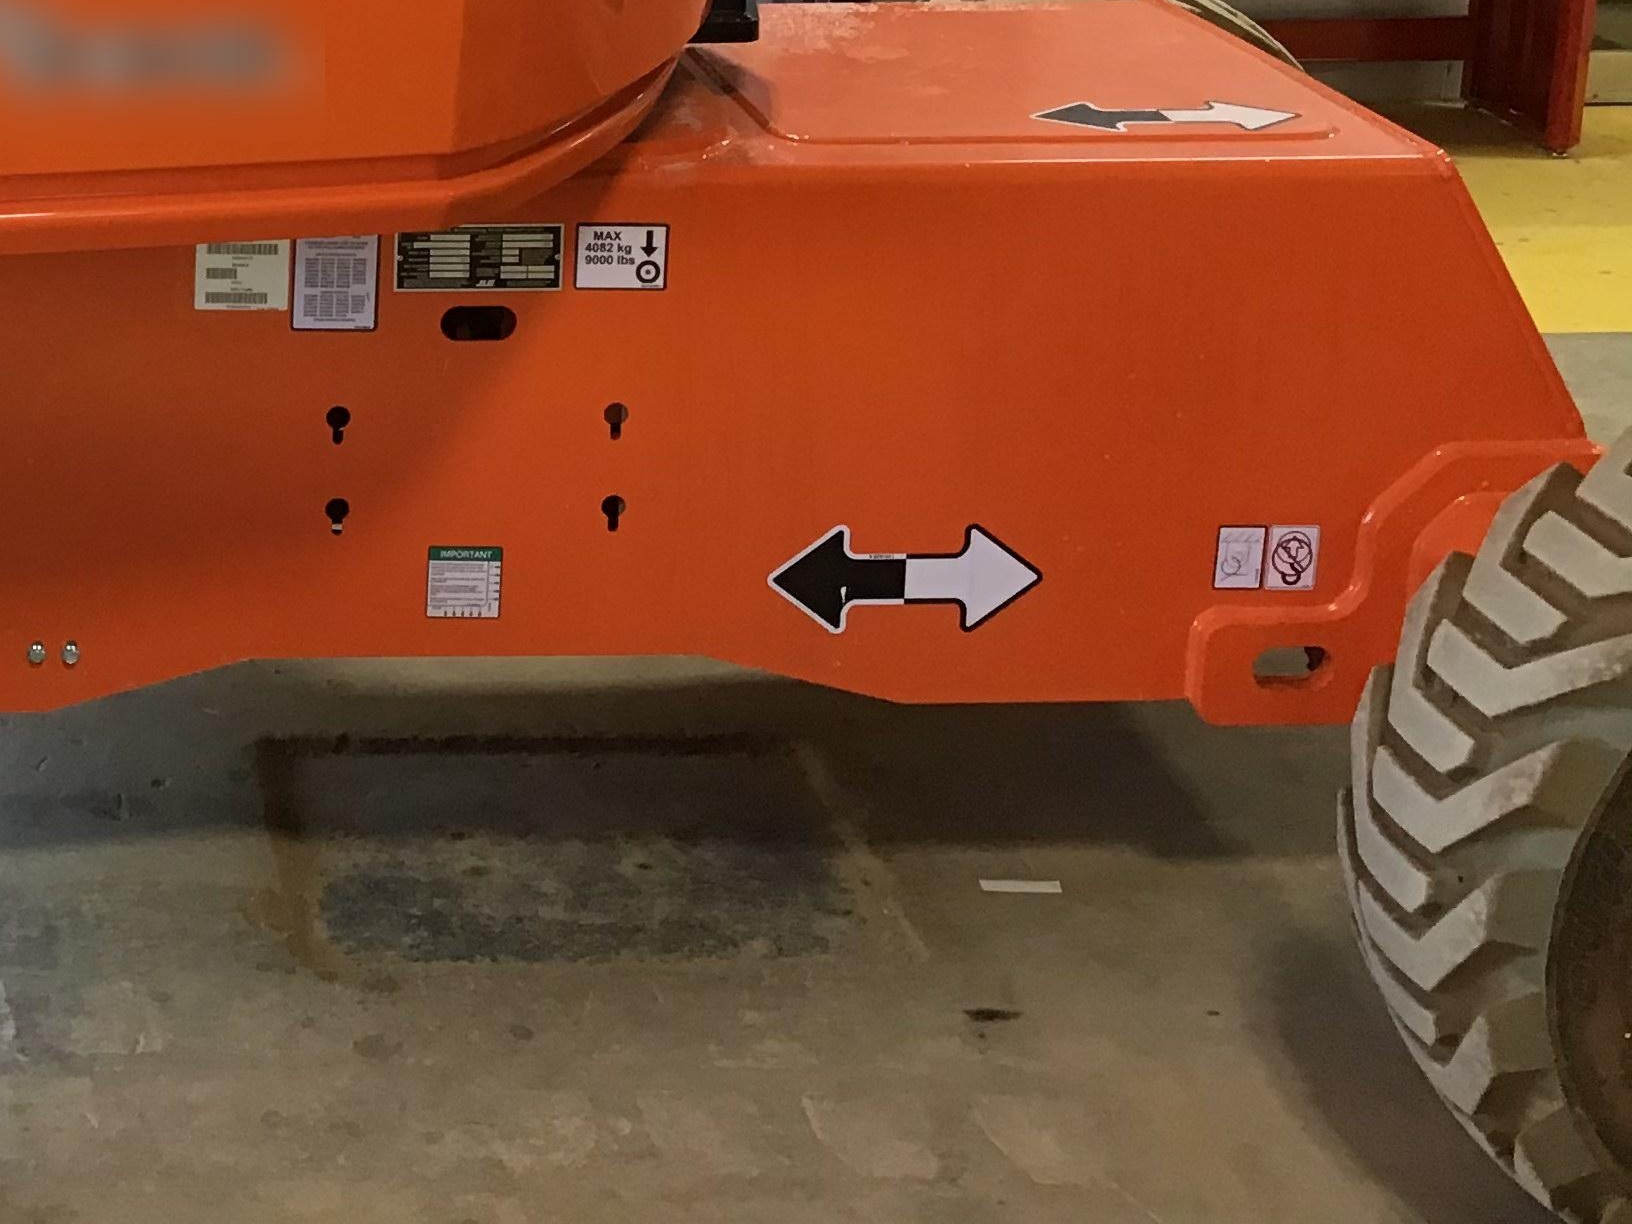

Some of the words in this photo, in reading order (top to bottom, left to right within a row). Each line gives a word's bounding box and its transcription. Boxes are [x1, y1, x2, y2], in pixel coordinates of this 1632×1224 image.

[593, 230, 623, 241] MAX
[584, 242, 614, 253] 4082
[617, 242, 632, 255] kg
[584, 255, 614, 265] 9000
[617, 255, 635, 265] lbs
[440, 550, 493, 559] IMPORTANT
